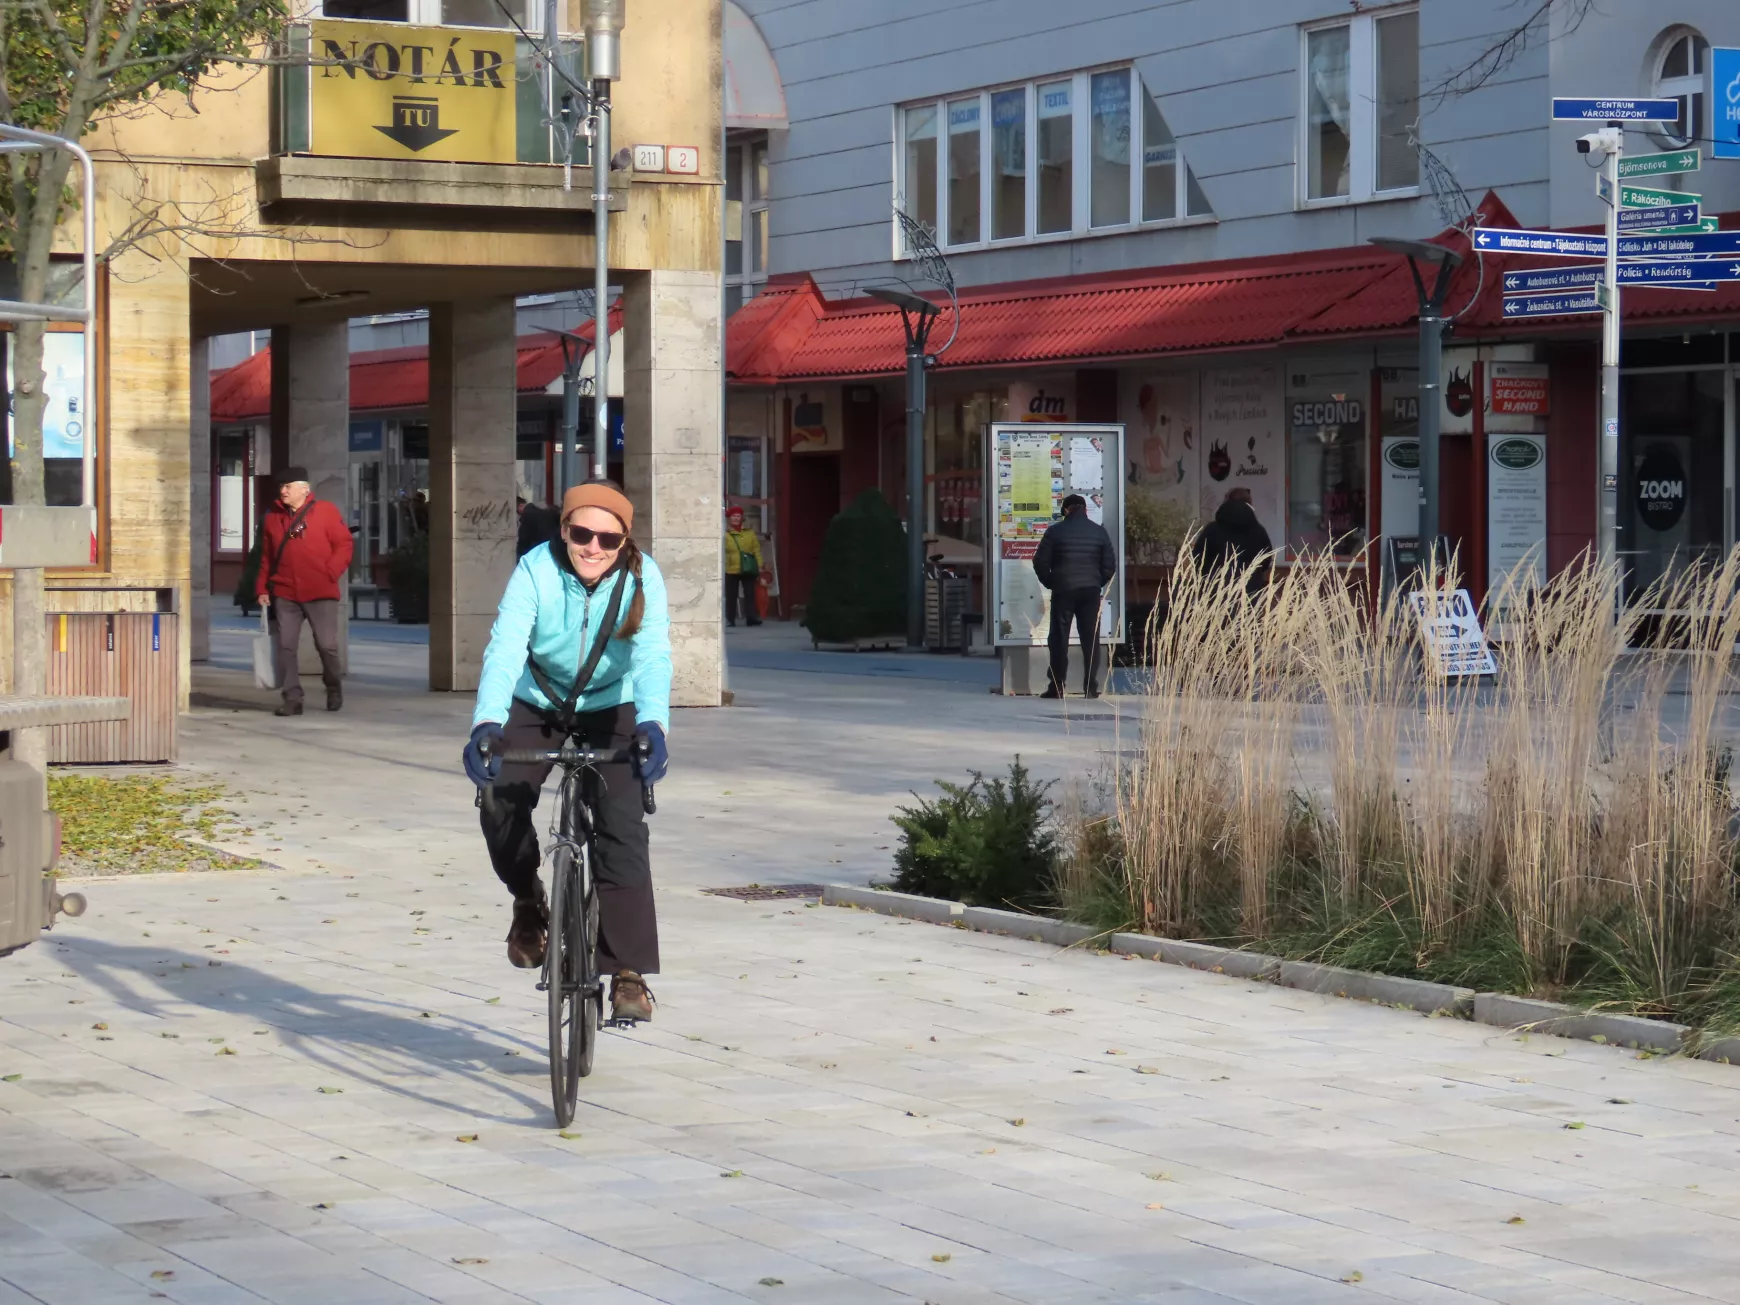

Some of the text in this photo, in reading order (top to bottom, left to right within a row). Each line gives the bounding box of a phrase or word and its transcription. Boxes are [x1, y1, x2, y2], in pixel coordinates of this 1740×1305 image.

[321, 36, 507, 89] NOTÁR
[1044, 92, 1069, 108] TEXTIL
[1596, 101, 1634, 109] CENTRUM
[400, 108, 431, 127] TU
[1581, 109, 1648, 118] VÁROSKÖZPONT
[640, 151, 656, 166] 211
[679, 153, 687, 168] 2
[1623, 192, 1629, 202] F.
[1621, 212, 1642, 222] Galéria
[1500, 235, 1530, 248] Informačné
[1530, 239, 1552, 249] centrum
[1585, 241, 1606, 253] központ
[1619, 240, 1694, 252] Sídlisko Juh Dél lakótelep
[1527, 275, 1558, 287] Autobusová
[1570, 272, 1595, 283] Autobusz
[1618, 267, 1643, 277] Polícia
[1526, 299, 1555, 312] Železničná
[1029, 390, 1065, 413] dm
[1496, 389, 1545, 400] SECOND
[1293, 402, 1361, 425] SECOND
[1394, 399, 1419, 419] HA
[1503, 401, 1538, 412] HAND
[1639, 480, 1683, 499] ZOOM
[1647, 501, 1674, 511] BISTRO
